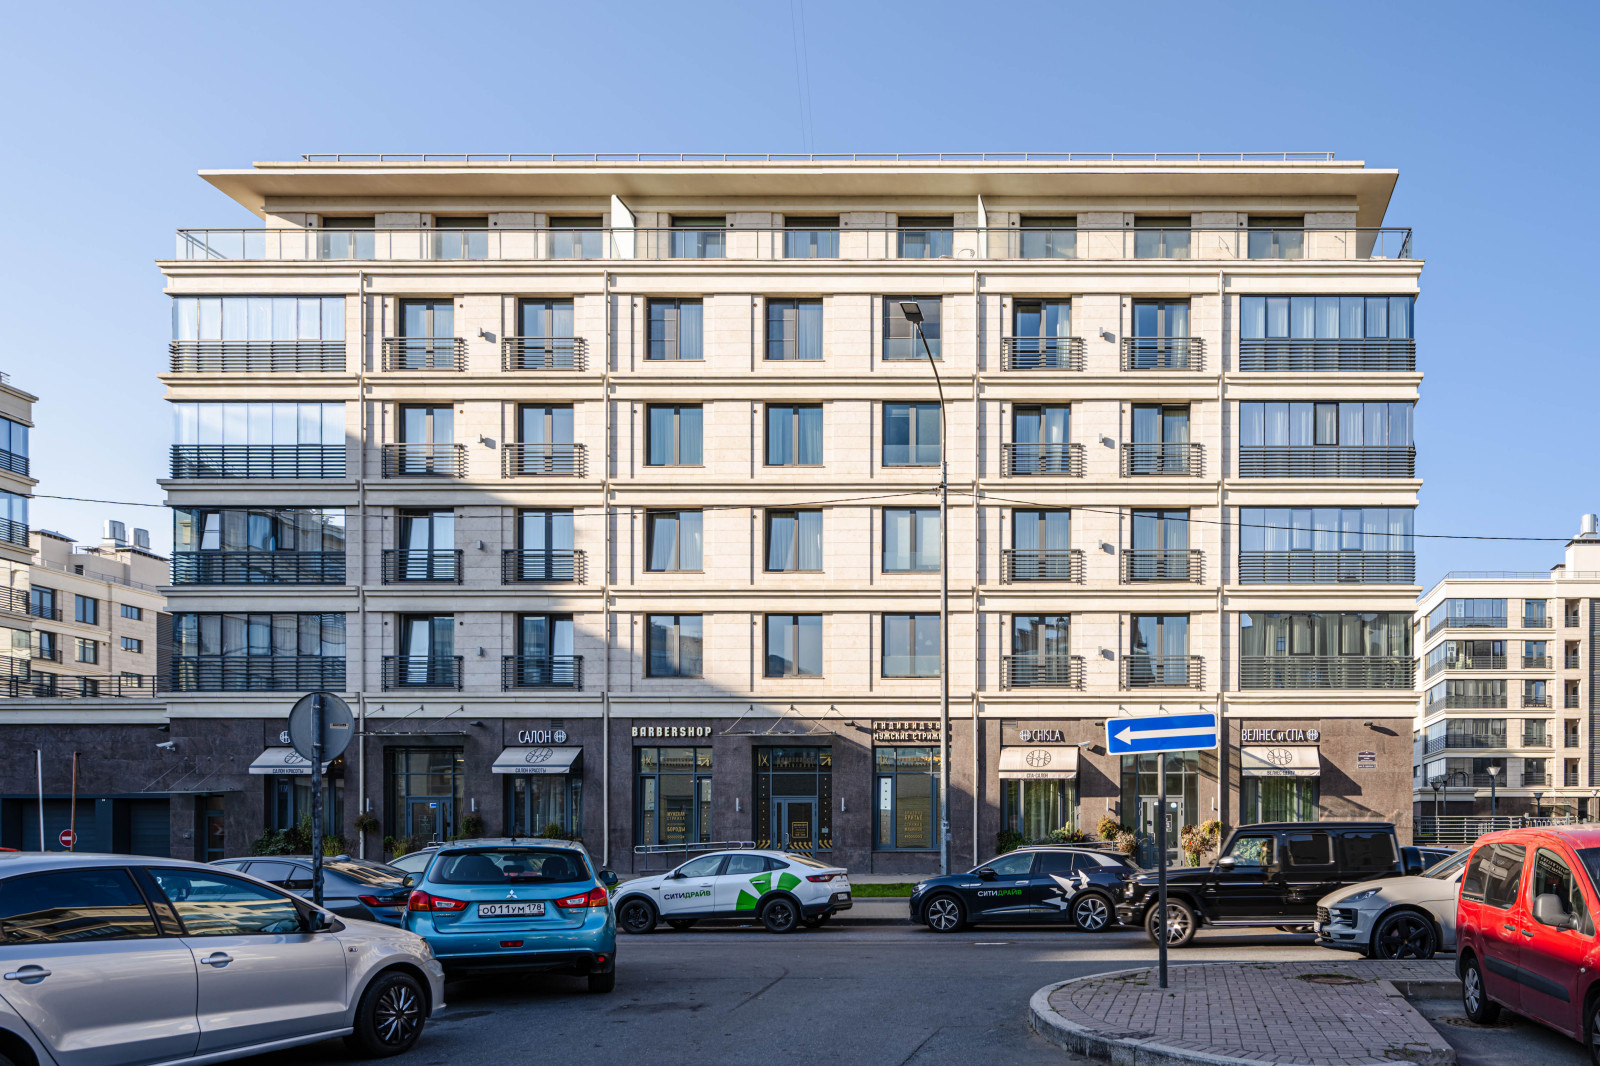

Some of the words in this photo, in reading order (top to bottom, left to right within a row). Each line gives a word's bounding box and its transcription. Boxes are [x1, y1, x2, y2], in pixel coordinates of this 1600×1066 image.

[632, 726, 711, 737] BARBERSHOP
[873, 721, 941, 730] ИНДИВИДУА
[518, 730, 551, 743] САЛОН
[873, 732, 909, 740] МУЖСКИЕ
[1032, 728, 1061, 741] CHISLA
[1241, 728, 1277, 741] ВЕЛНЕС
[1278, 732, 1284, 741] и
[1285, 728, 1305, 741] СПА
[663, 889, 711, 901] СИТИДРАЙВ
[977, 888, 1023, 897] СИТИДРАЙВ
[482, 904, 525, 915] О011УМ
[526, 902, 542, 911] 178
